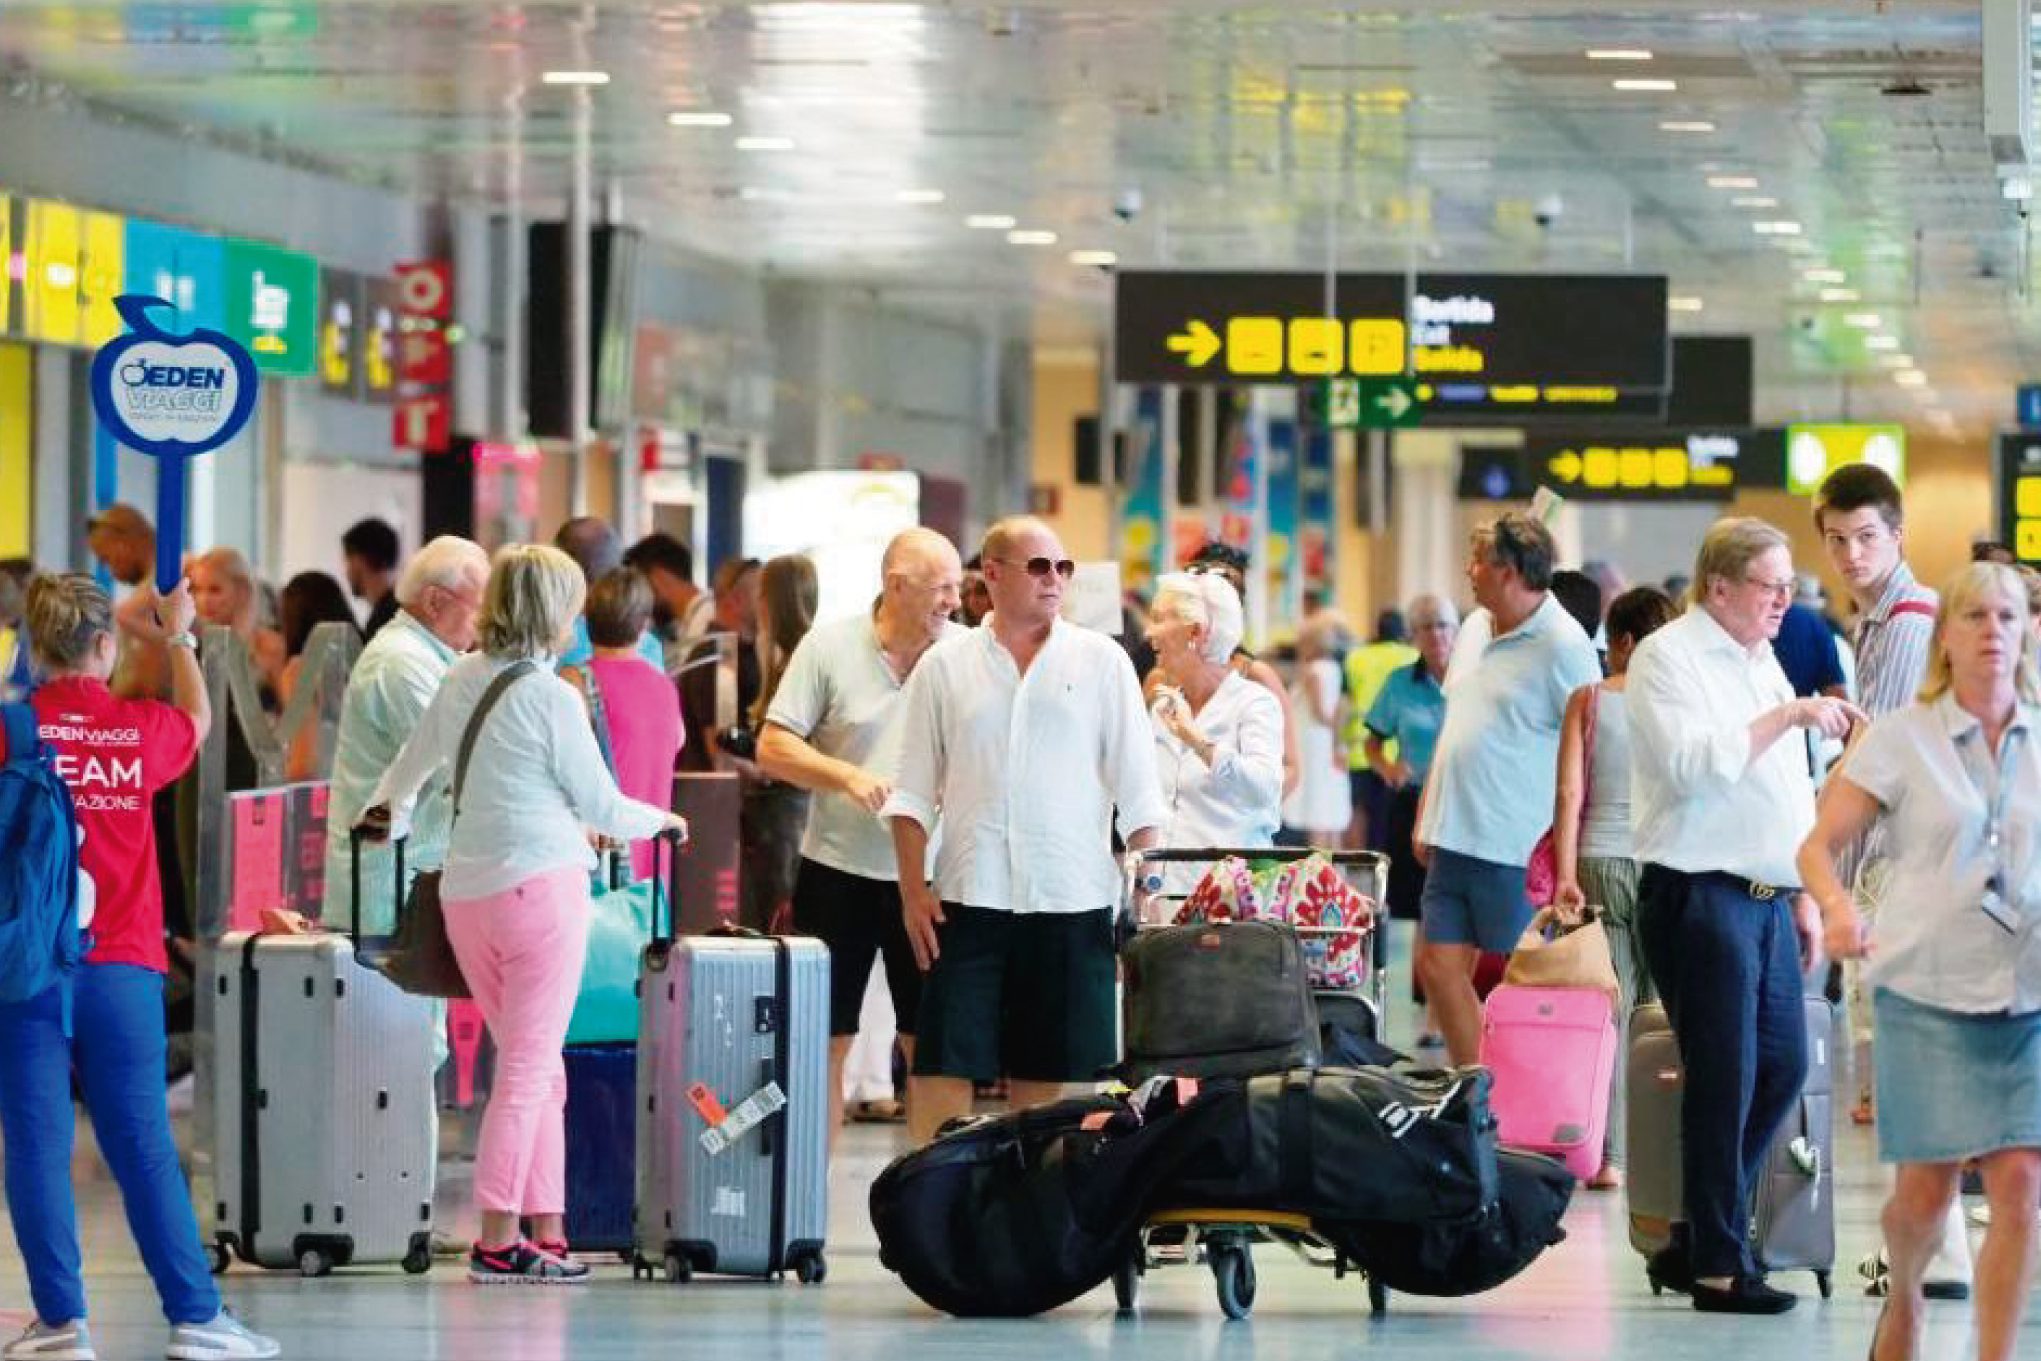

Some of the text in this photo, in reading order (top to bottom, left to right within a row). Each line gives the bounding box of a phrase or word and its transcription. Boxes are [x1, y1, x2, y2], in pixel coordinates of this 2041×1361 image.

[146, 366, 226, 389] EDEN
[40, 754, 143, 788] EAM
[71, 794, 140, 810] AZIONE
